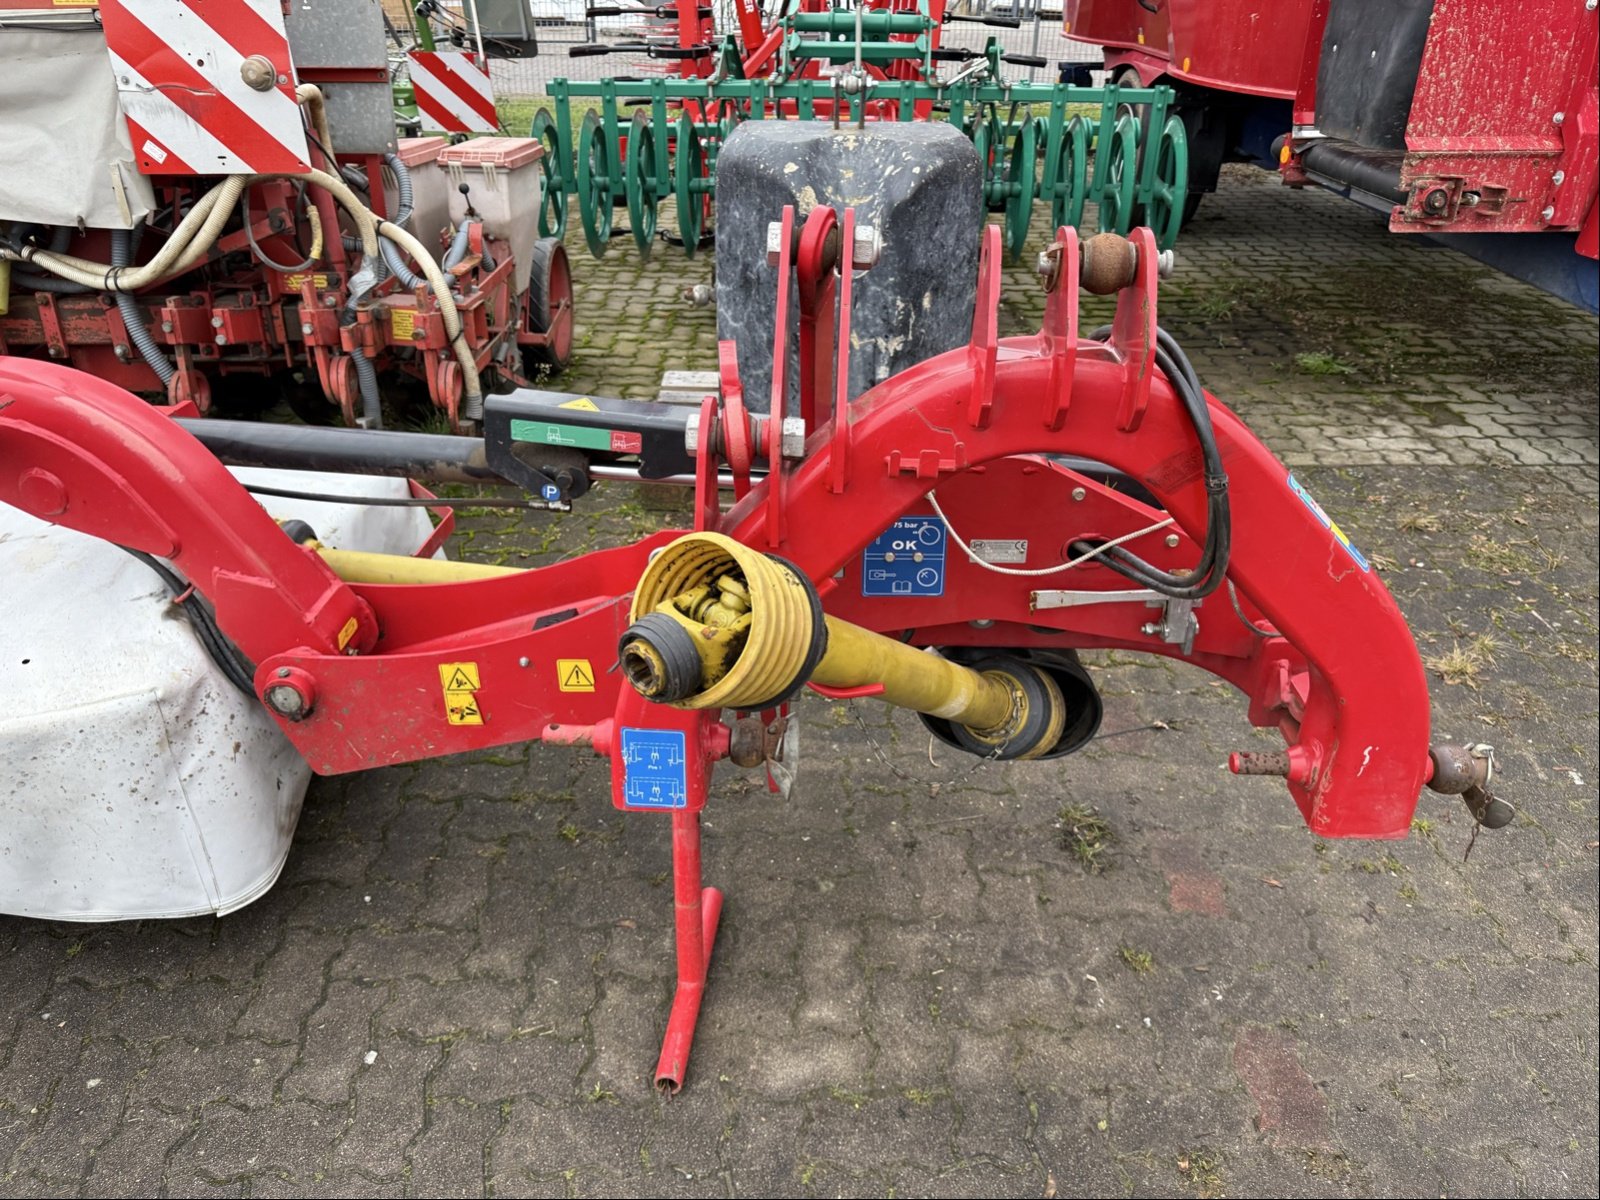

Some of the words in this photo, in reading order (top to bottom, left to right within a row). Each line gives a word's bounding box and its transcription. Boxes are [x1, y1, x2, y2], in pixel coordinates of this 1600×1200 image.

[547, 485, 557, 498] P
[892, 540, 917, 550] OK
[1014, 541, 1026, 550] CE
